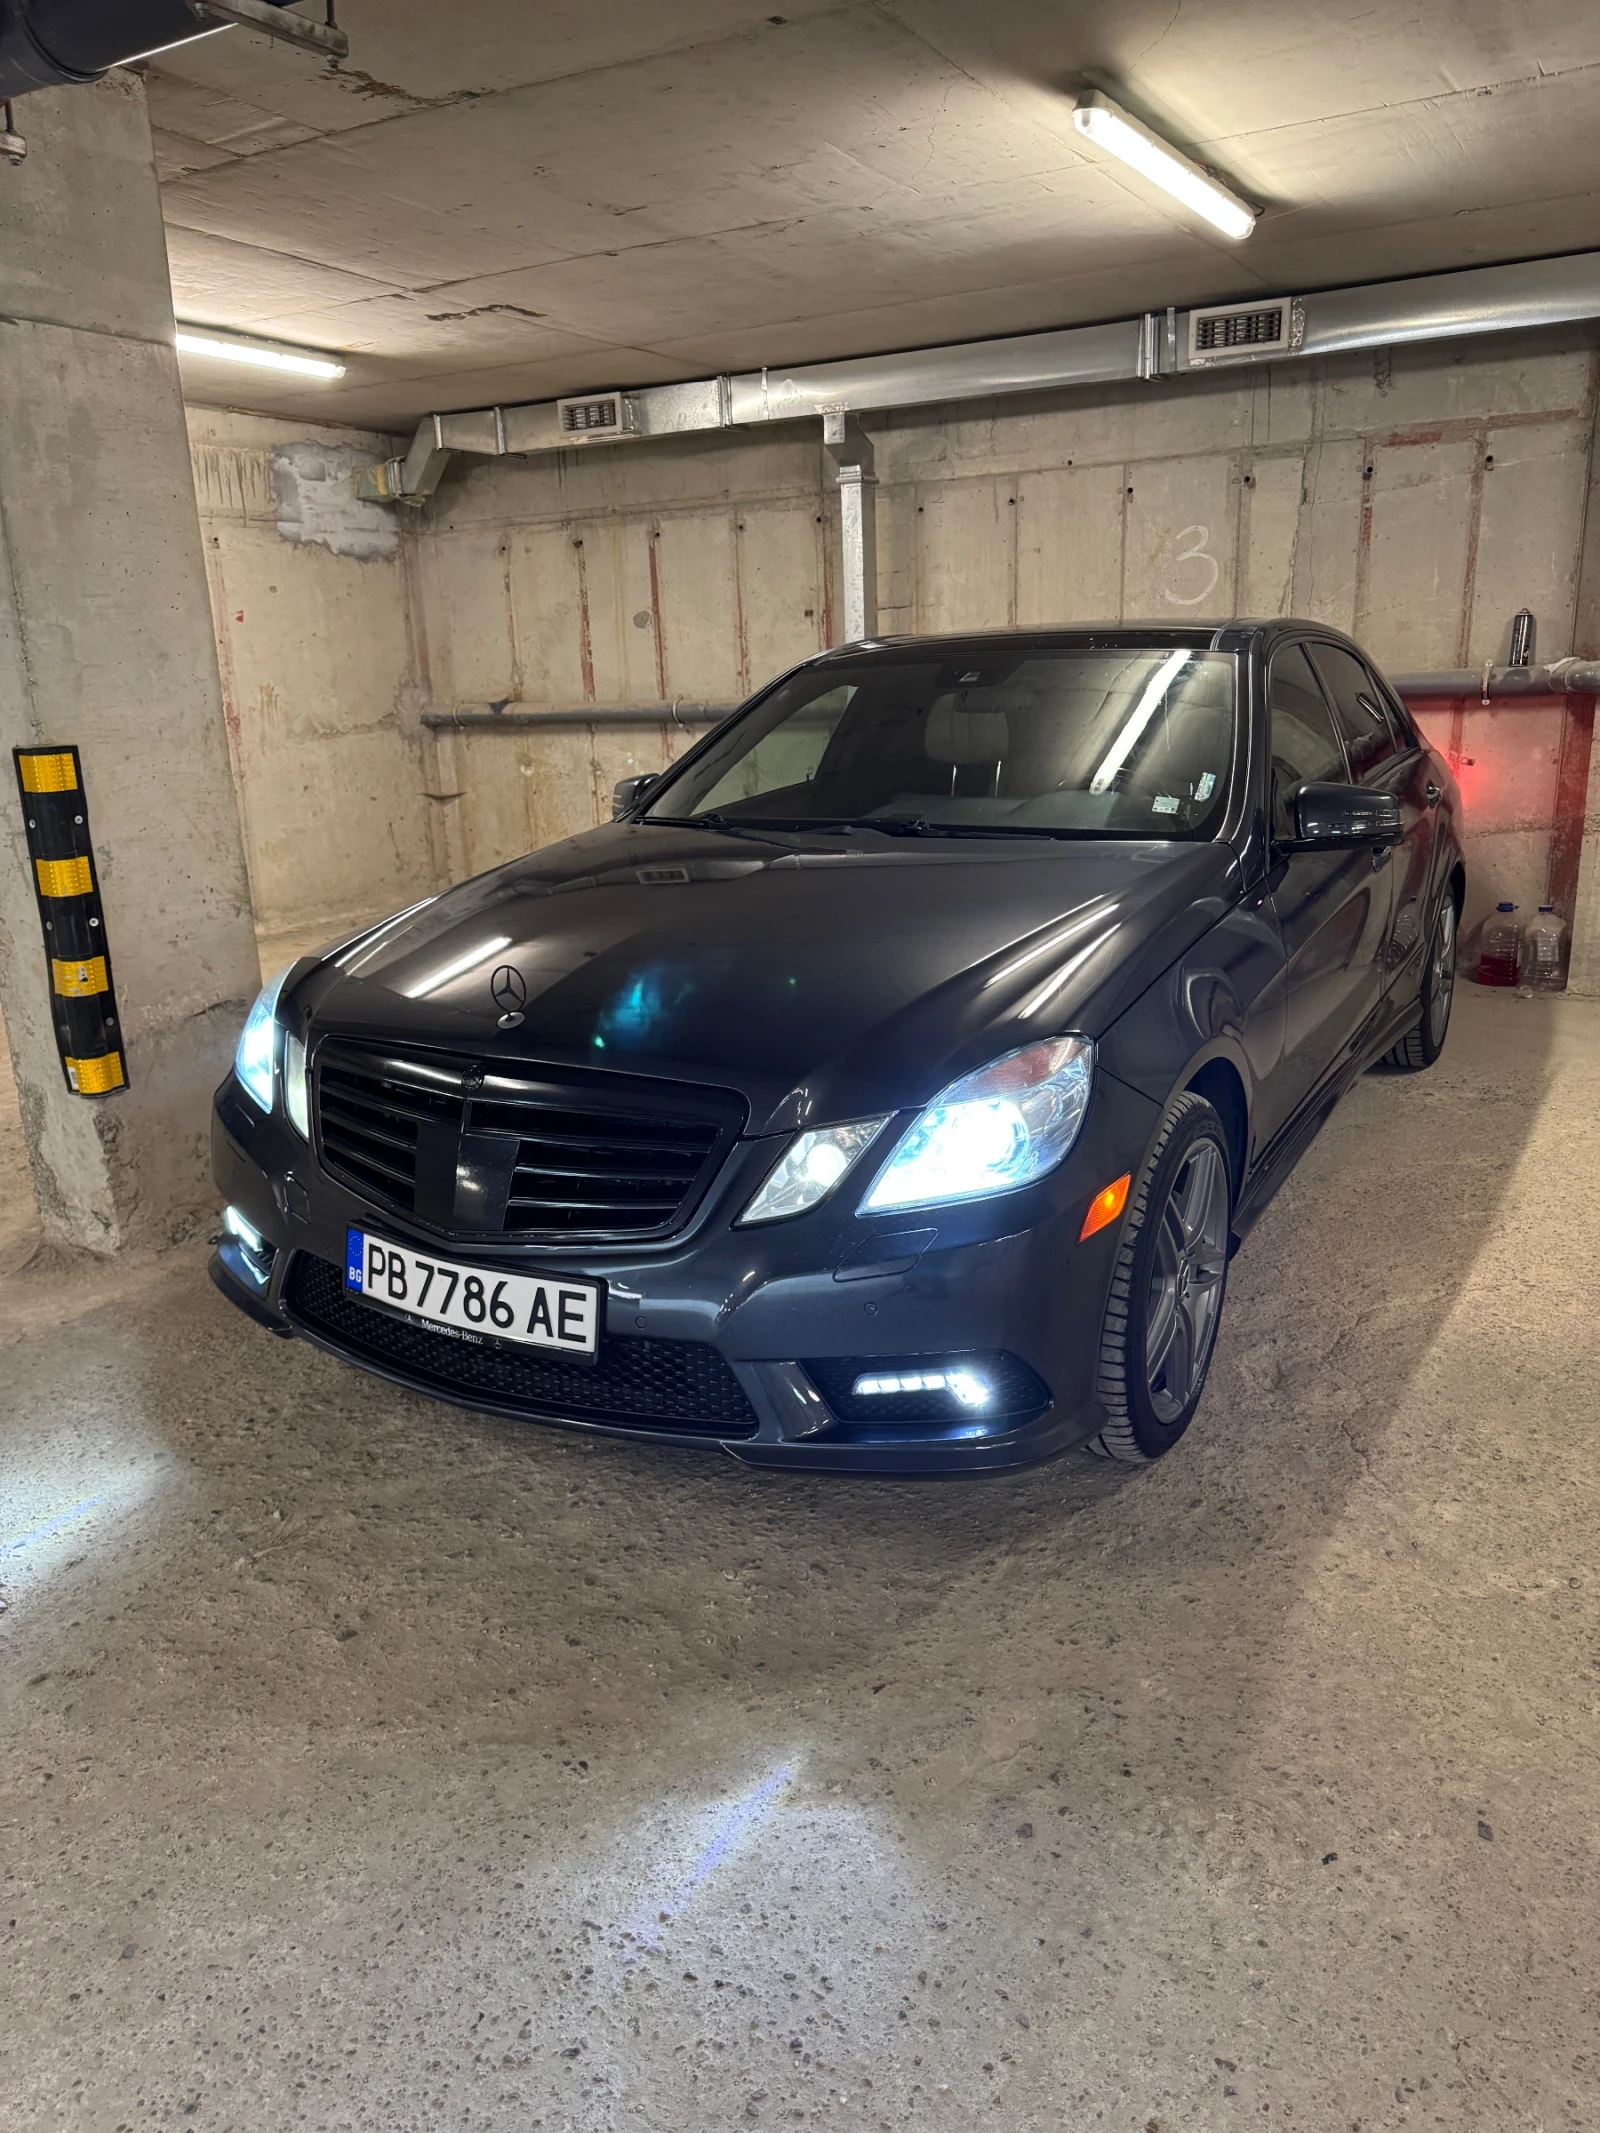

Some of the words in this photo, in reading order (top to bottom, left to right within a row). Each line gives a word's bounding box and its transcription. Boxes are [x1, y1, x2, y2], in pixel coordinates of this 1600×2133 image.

[1165, 525, 1218, 605] 3
[349, 1266, 362, 1283] BG
[368, 1243, 408, 1300] PB
[415, 1260, 514, 1329] 7786
[526, 1286, 587, 1343] AE
[421, 1319, 483, 1345] Mercedes-Benz
